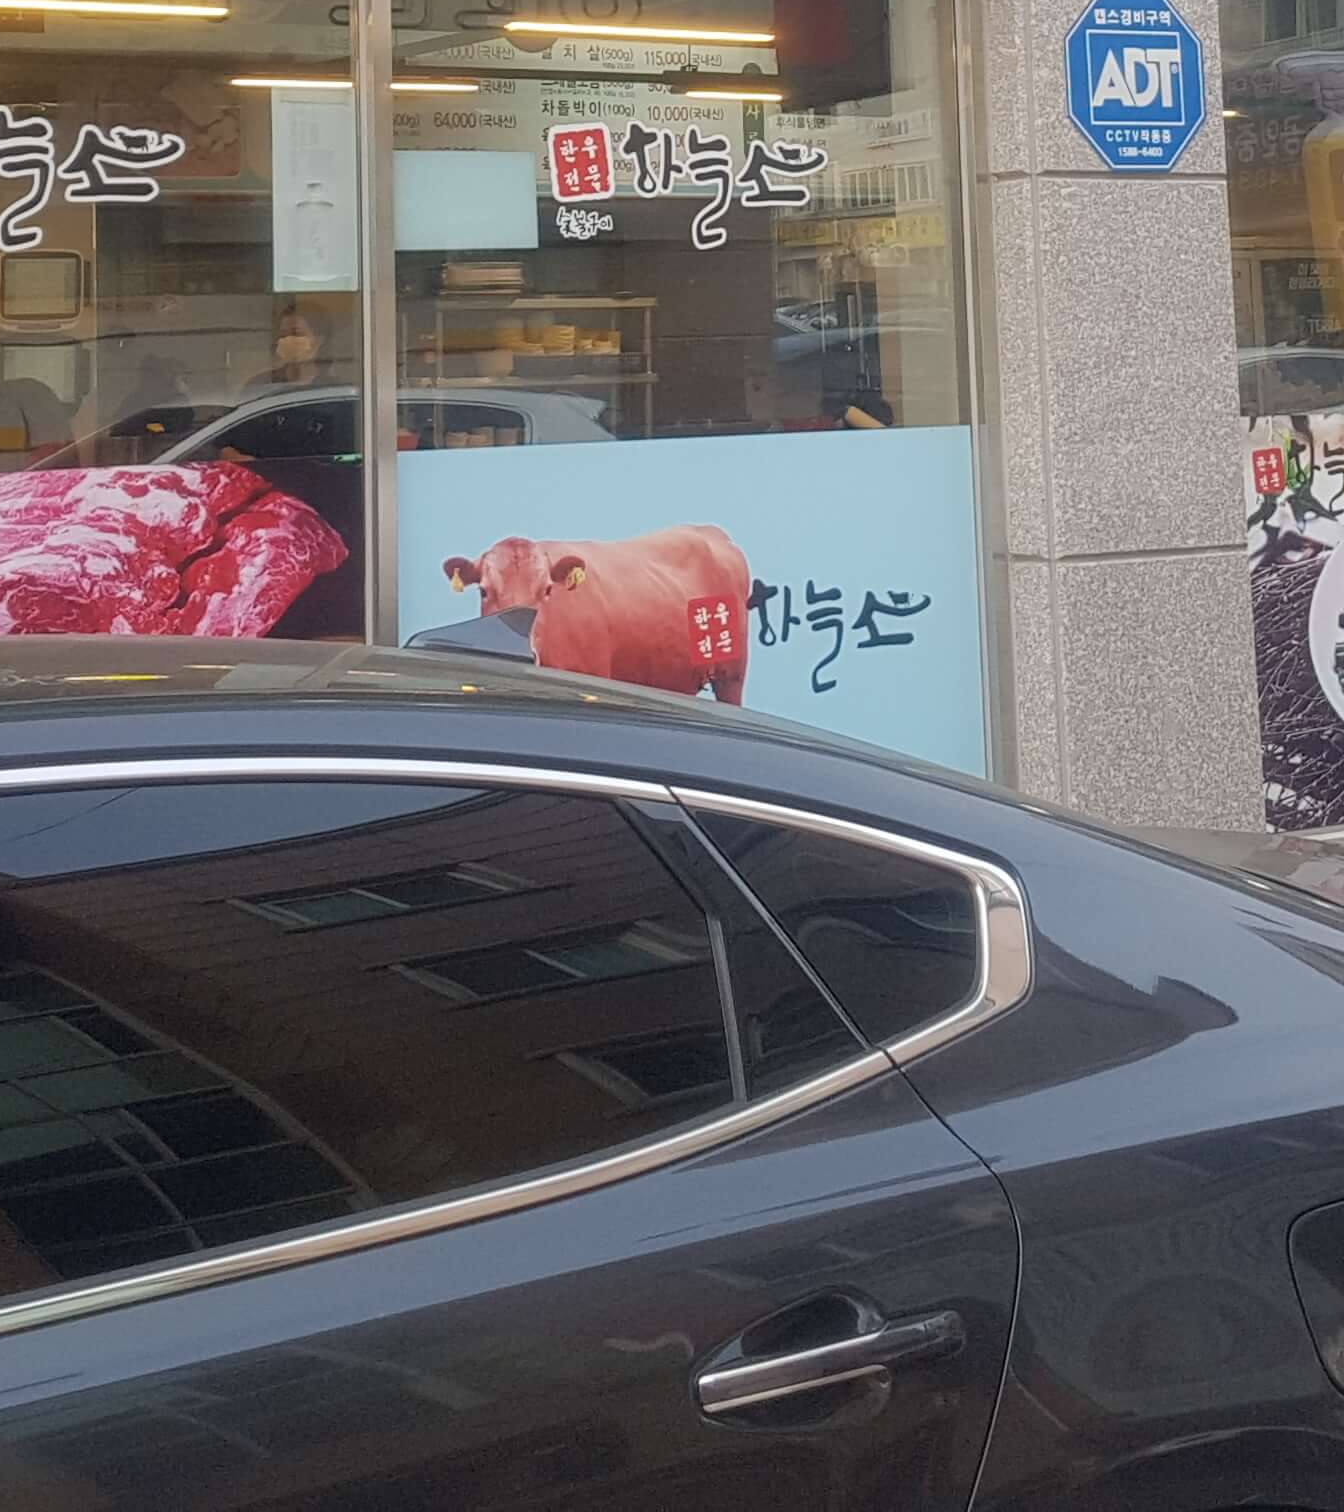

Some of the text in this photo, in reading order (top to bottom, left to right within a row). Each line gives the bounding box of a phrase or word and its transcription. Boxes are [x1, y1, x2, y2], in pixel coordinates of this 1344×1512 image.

[1092, 47, 1181, 108] ADT
[559, 135, 599, 163] 한우
[563, 164, 602, 192] 전문
[622, 120, 829, 251] 하늘소
[694, 601, 731, 630] 한우
[746, 577, 932, 694] 하늘소
